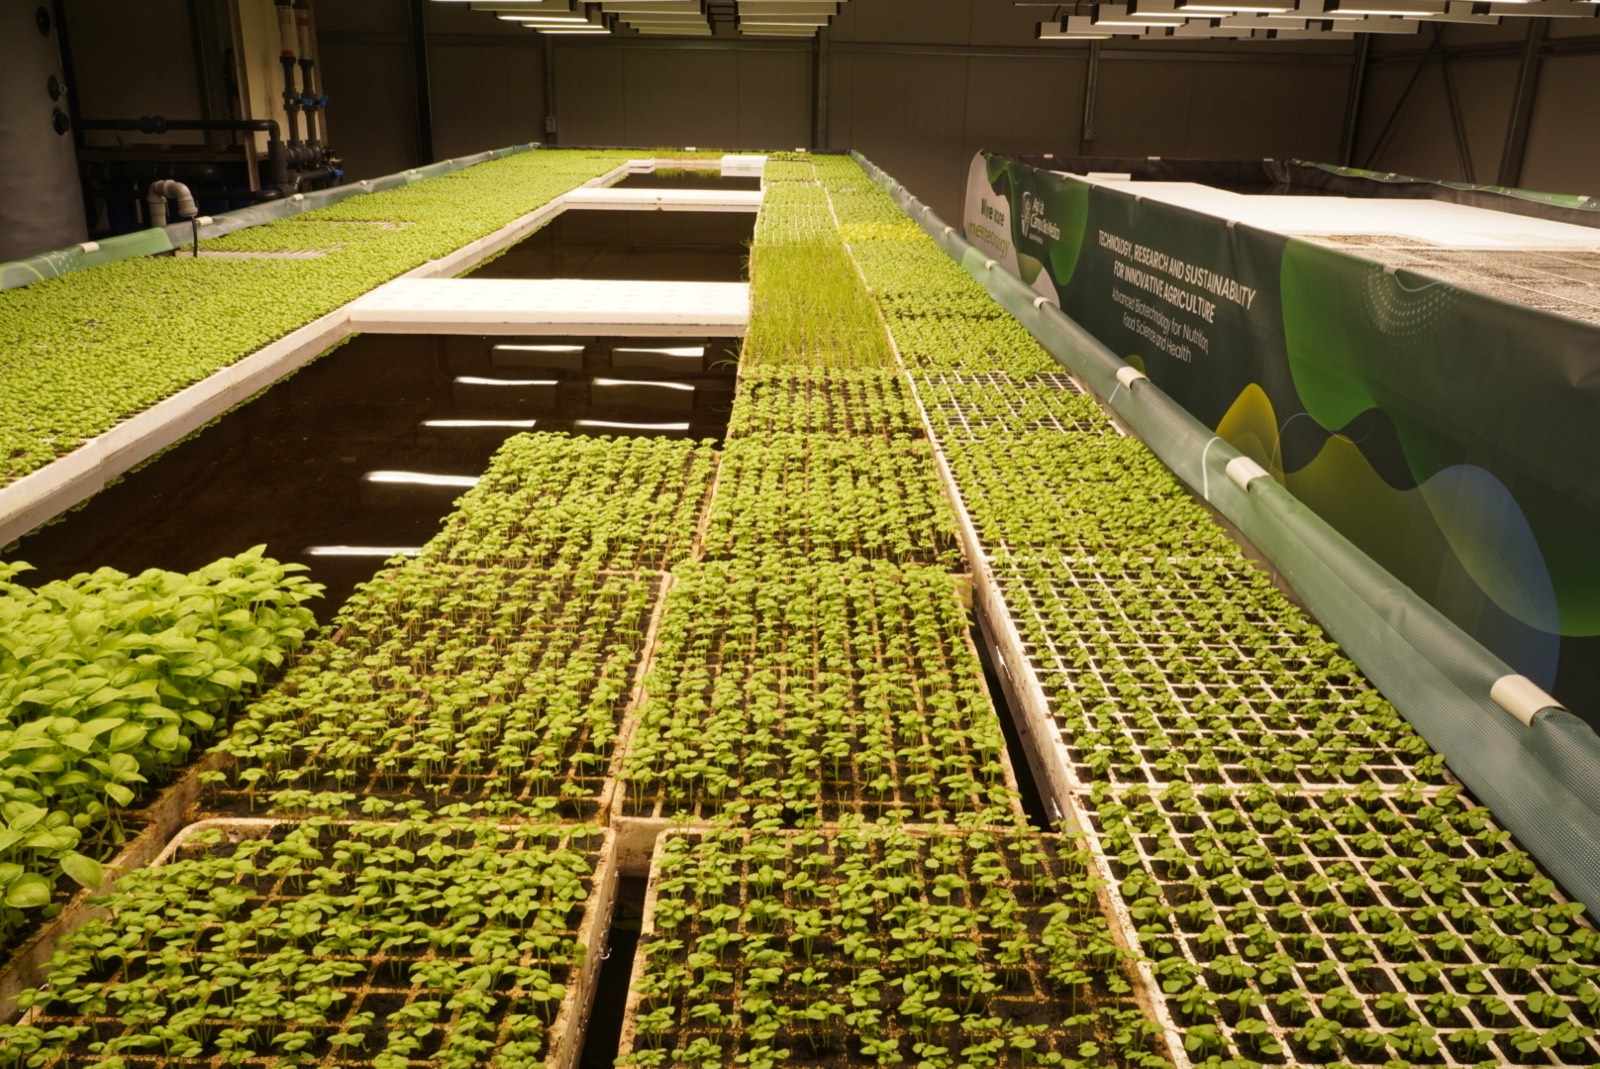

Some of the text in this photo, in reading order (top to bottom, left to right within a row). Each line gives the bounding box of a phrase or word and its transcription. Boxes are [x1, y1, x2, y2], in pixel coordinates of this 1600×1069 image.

[1099, 229, 1133, 261] TECHNOLOGY,
[1134, 244, 1169, 273] RESEARCH
[1168, 257, 1184, 279] AND
[1114, 260, 1216, 324] FOR INNOVATIVE AGRICULTURE
[1134, 297, 1171, 335] Biotechnology
[1171, 318, 1182, 336] for
[1123, 311, 1192, 364] Food Science and Health
